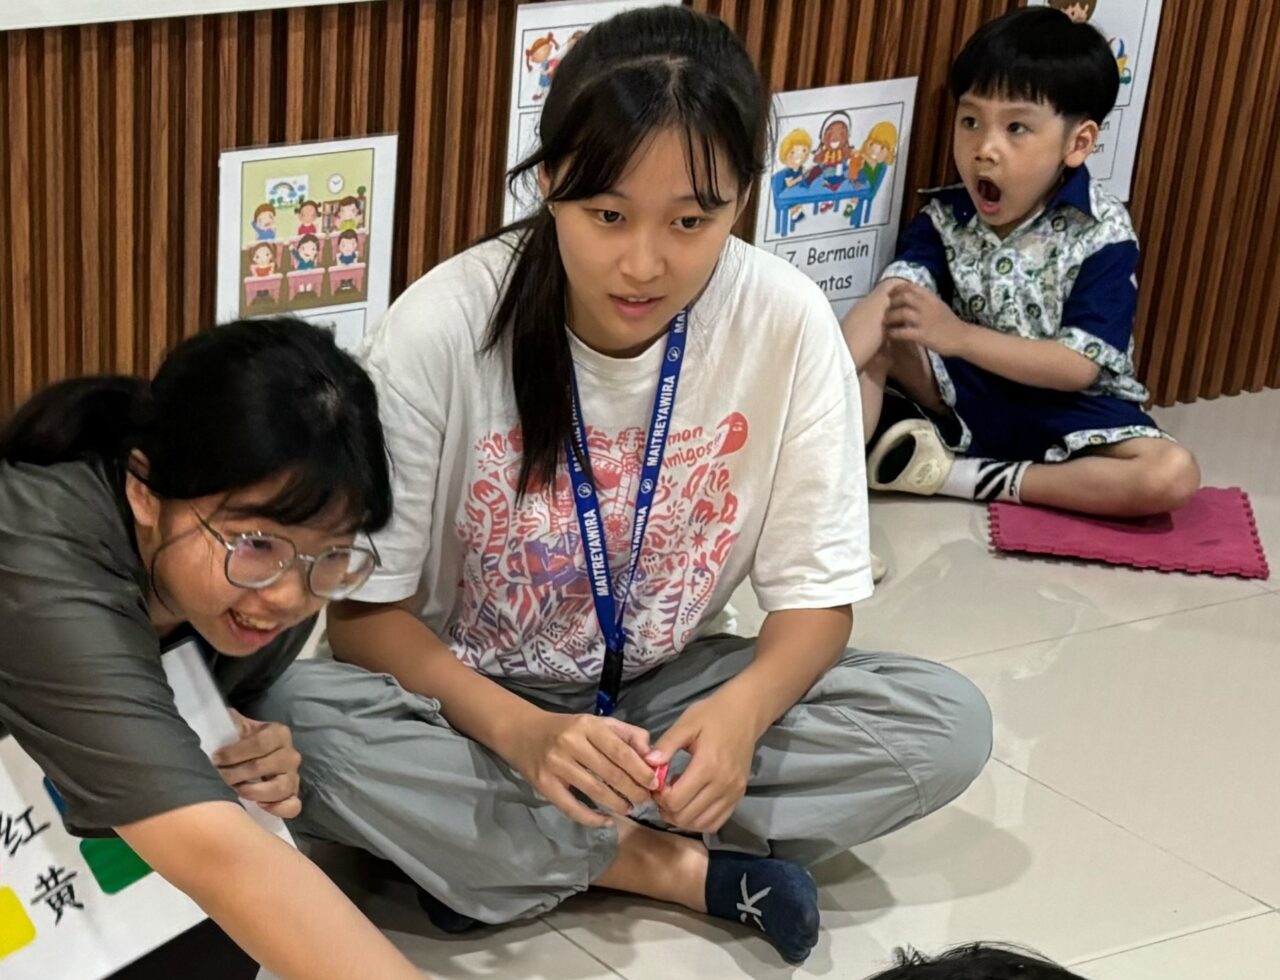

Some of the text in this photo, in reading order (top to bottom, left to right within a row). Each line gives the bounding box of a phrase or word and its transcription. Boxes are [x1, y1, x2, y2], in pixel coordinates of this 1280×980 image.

[806, 240, 869, 266] Bermain
[646, 375, 676, 467] MAITREYAWIRA
[583, 509, 610, 597] MAITREYAWIRA
[29, 865, 85, 926] 黄
